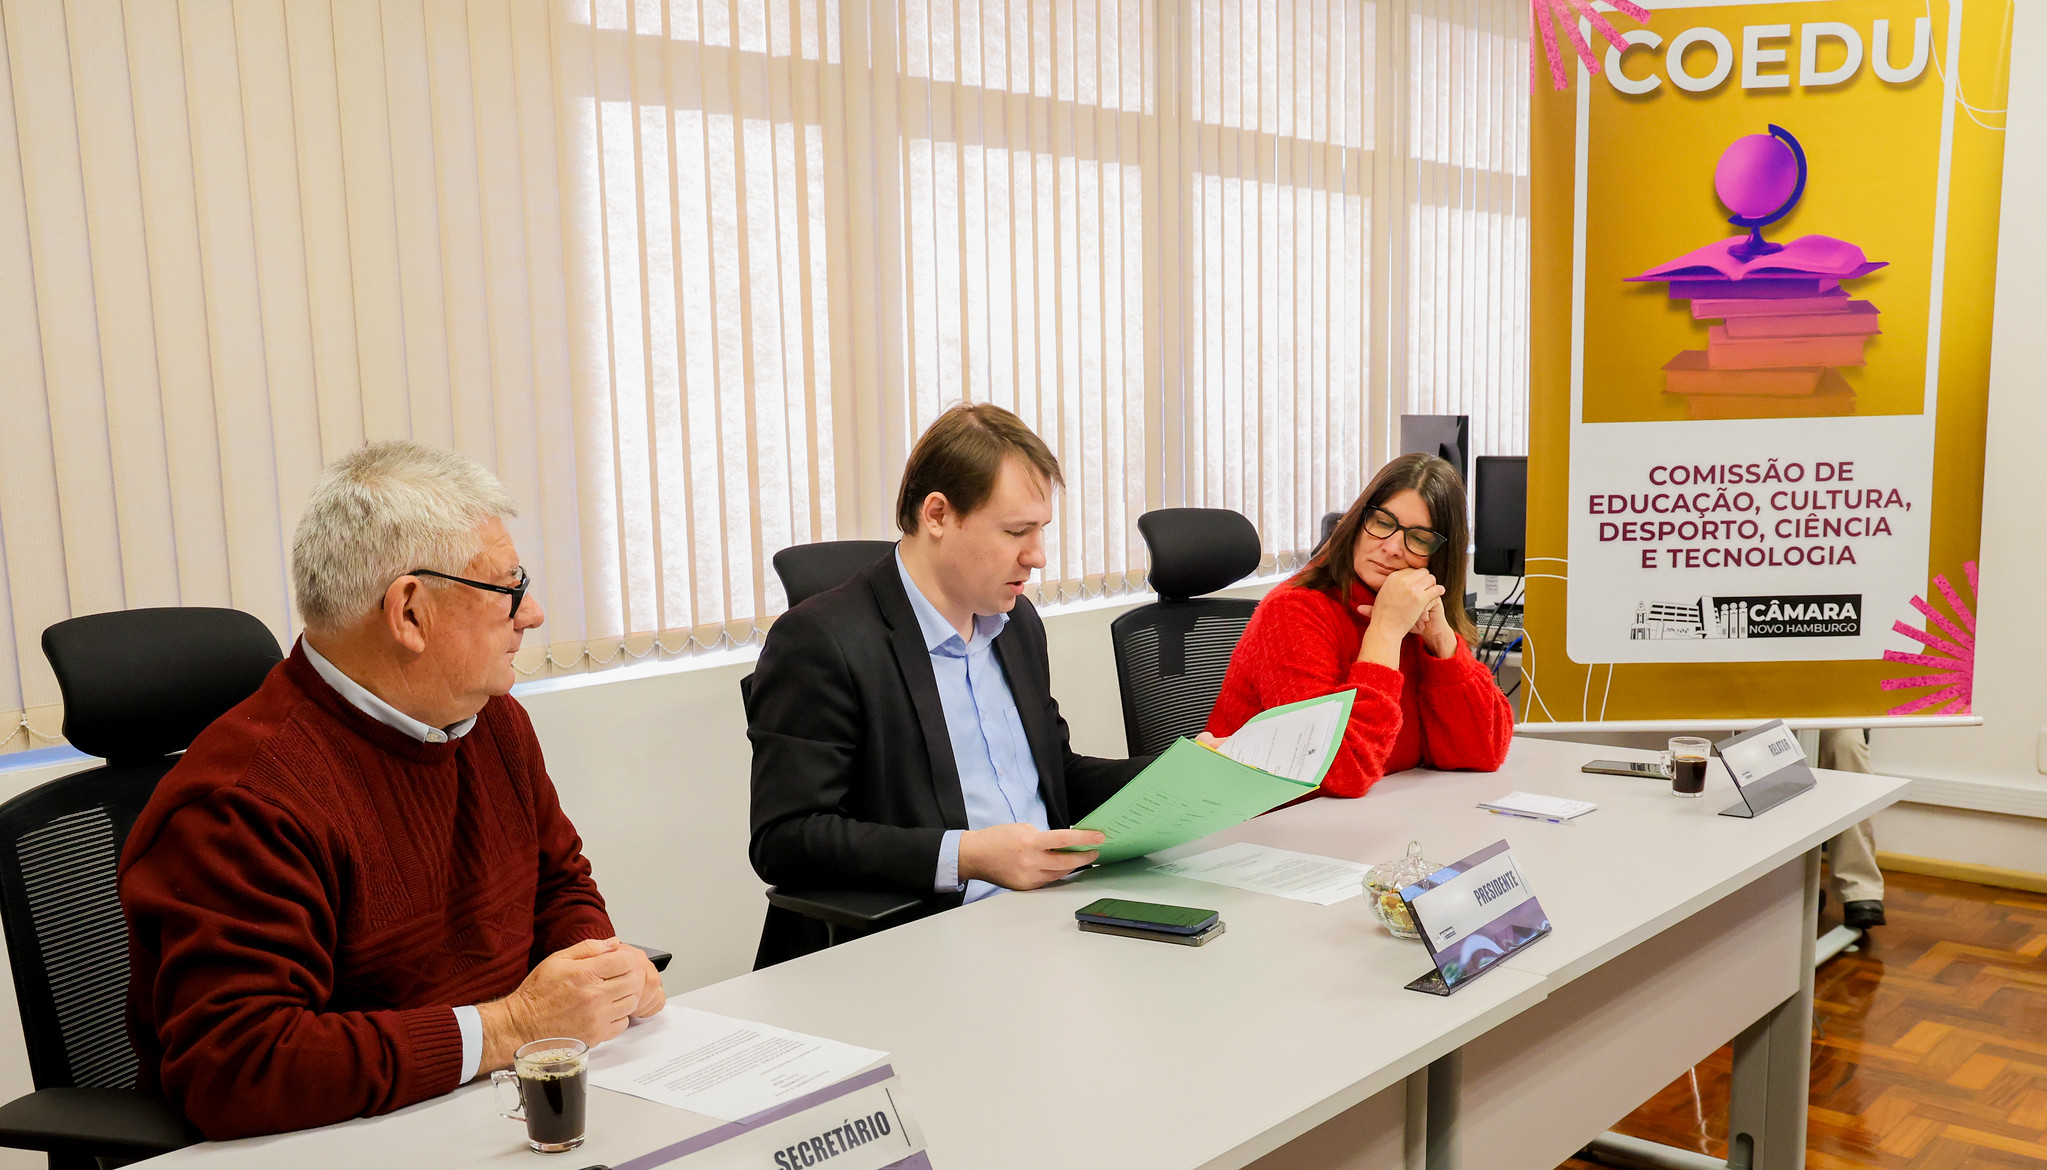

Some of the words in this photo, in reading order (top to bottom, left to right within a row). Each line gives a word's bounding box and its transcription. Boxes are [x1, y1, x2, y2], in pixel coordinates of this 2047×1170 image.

[1604, 17, 1932, 95] COEDU
[1649, 458, 1805, 486] COMISSÃO
[1814, 461, 1855, 483] DE
[1588, 487, 1761, 519] EDUCAÇÃO,
[1770, 488, 1912, 512] CULTURA,
[1599, 519, 1766, 543] DESPORTO,
[1774, 513, 1893, 540] CIÊNCIA
[1641, 549, 1658, 569] E
[1667, 545, 1857, 568] TECNOLOGIA
[1749, 600, 1858, 622] CÂMARA
[1749, 623, 1784, 635] NOVO
[1785, 622, 1858, 634] HAMBURGO
[1768, 738, 1792, 757] RELATOR
[1473, 870, 1519, 907] PRESIDENTE
[774, 1111, 891, 1170] SECRETÁRIO
